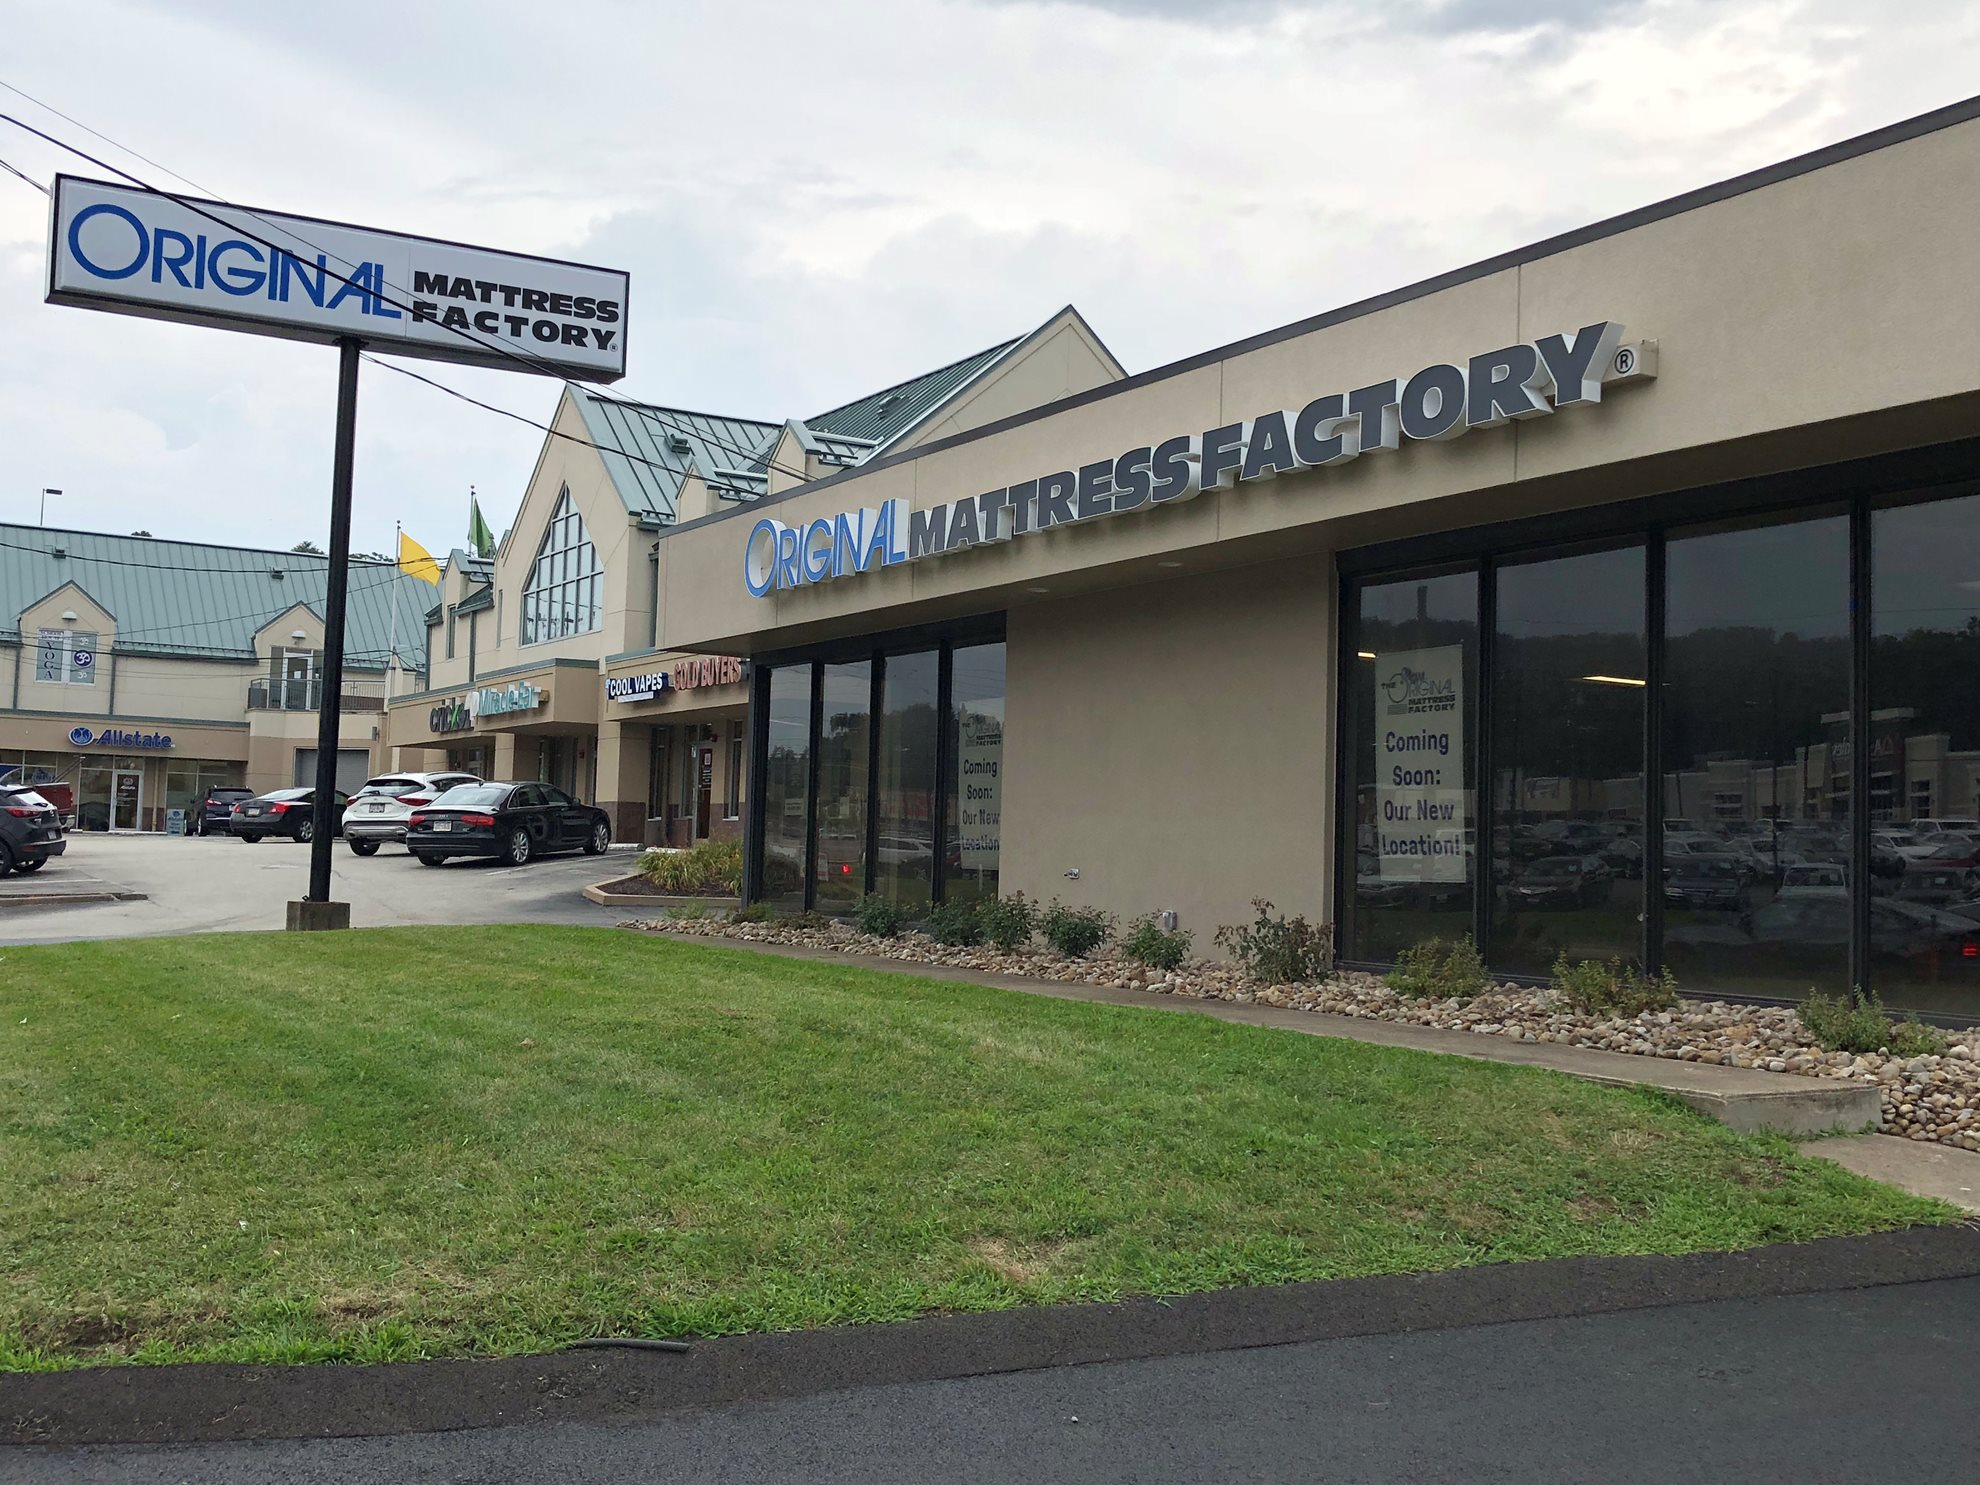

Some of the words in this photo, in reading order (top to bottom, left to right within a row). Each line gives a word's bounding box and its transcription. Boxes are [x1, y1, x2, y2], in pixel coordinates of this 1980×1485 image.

[68, 203, 402, 320] ORIGINAL
[413, 271, 620, 323] MATTRESS
[745, 498, 908, 597] ORIGINAL
[909, 436, 1192, 558] MATTRESS
[1201, 321, 1607, 490] FACTORY
[610, 676, 632, 696] COOL
[634, 672, 663, 693] VAPES
[674, 659, 700, 691] GOLD
[701, 656, 742, 687] BUYERS
[1408, 703, 1456, 714] FACTORY
[95, 729, 172, 749] Allstate
[1385, 729, 1449, 755] Coming
[963, 759, 997, 778] Coming
[1393, 766, 1441, 786] Soon:
[967, 785, 993, 800] Soon:
[962, 810, 977, 825] Our
[979, 809, 1000, 825] New
[1384, 800, 1412, 821] Our
[1417, 799, 1455, 821] New
[1381, 834, 1460, 856] Location!
